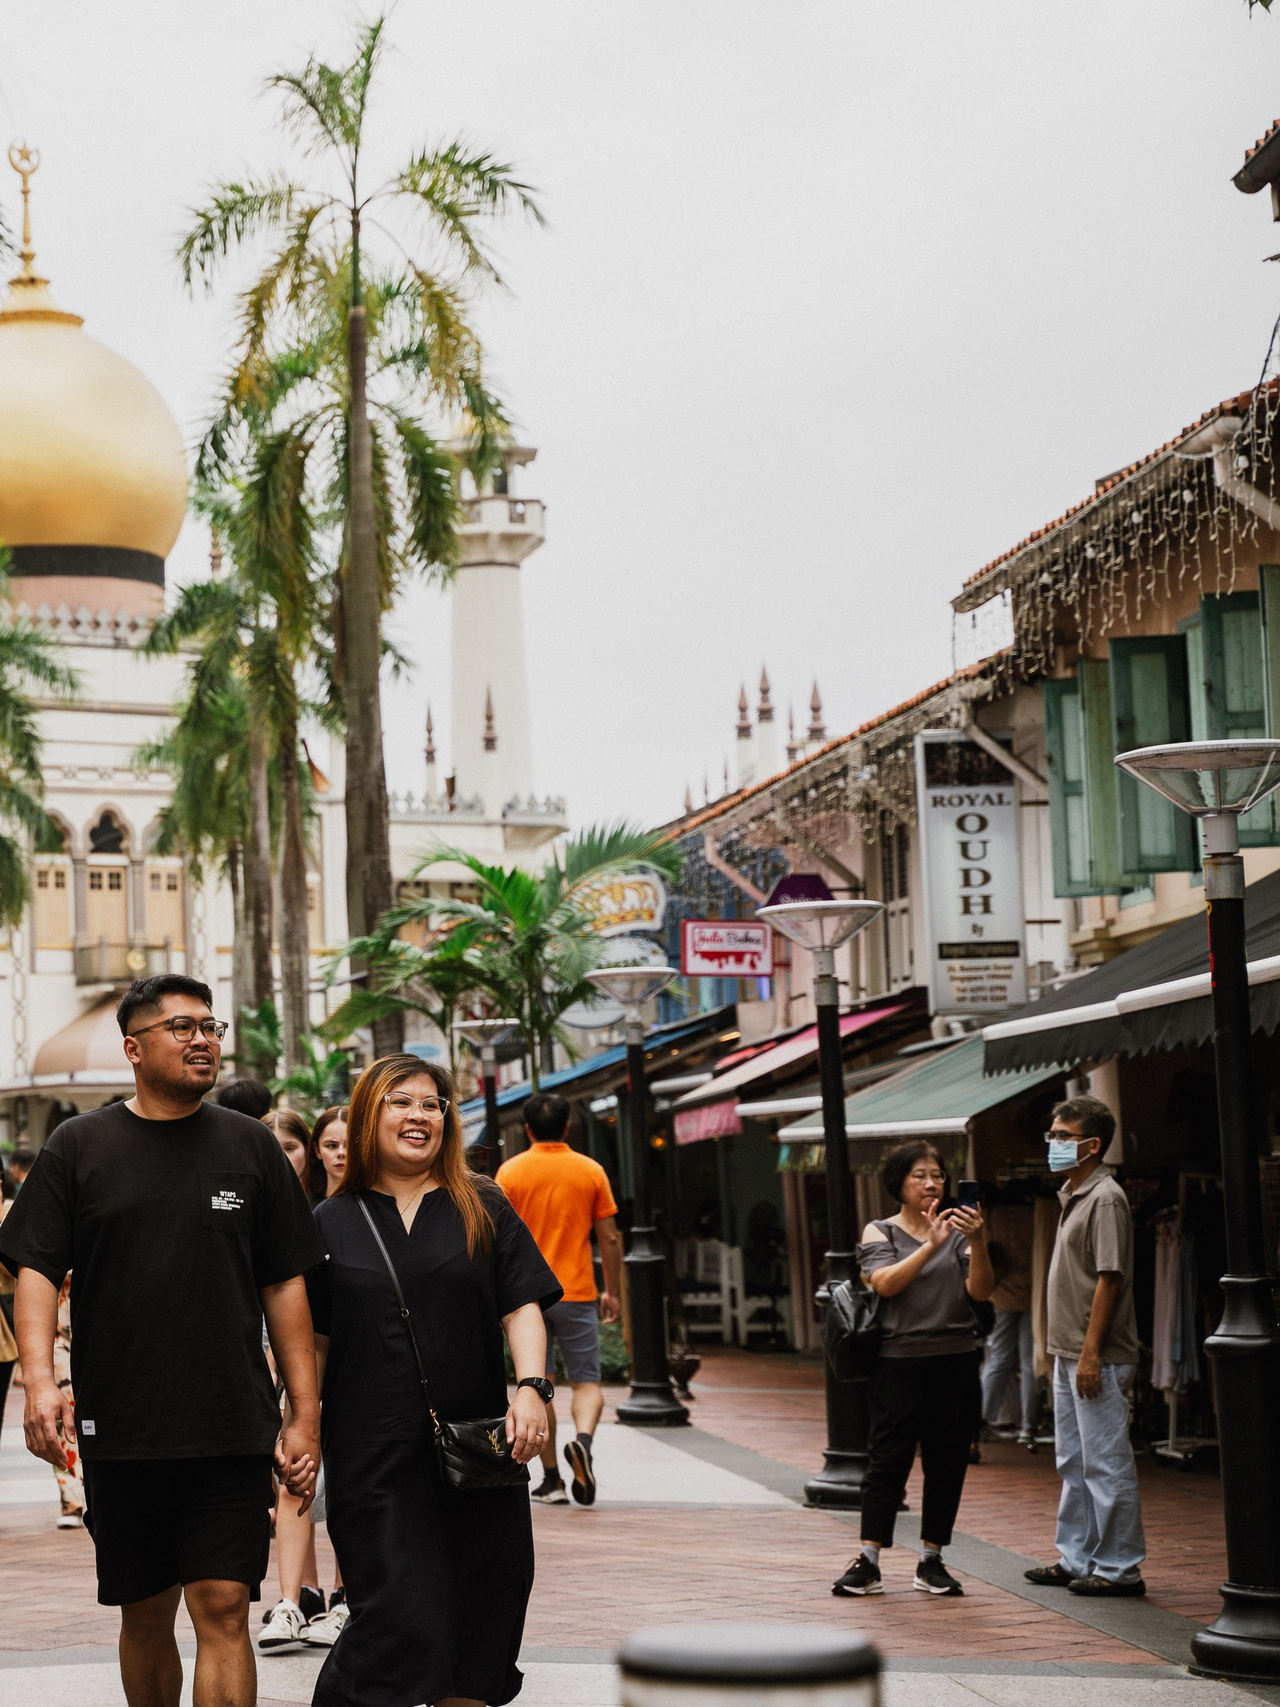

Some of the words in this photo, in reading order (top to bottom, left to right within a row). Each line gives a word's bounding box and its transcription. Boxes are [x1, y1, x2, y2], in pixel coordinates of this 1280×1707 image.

[931, 793, 1012, 808] ROYAL
[956, 812, 995, 916] OUDH
[972, 923, 984, 938] By
